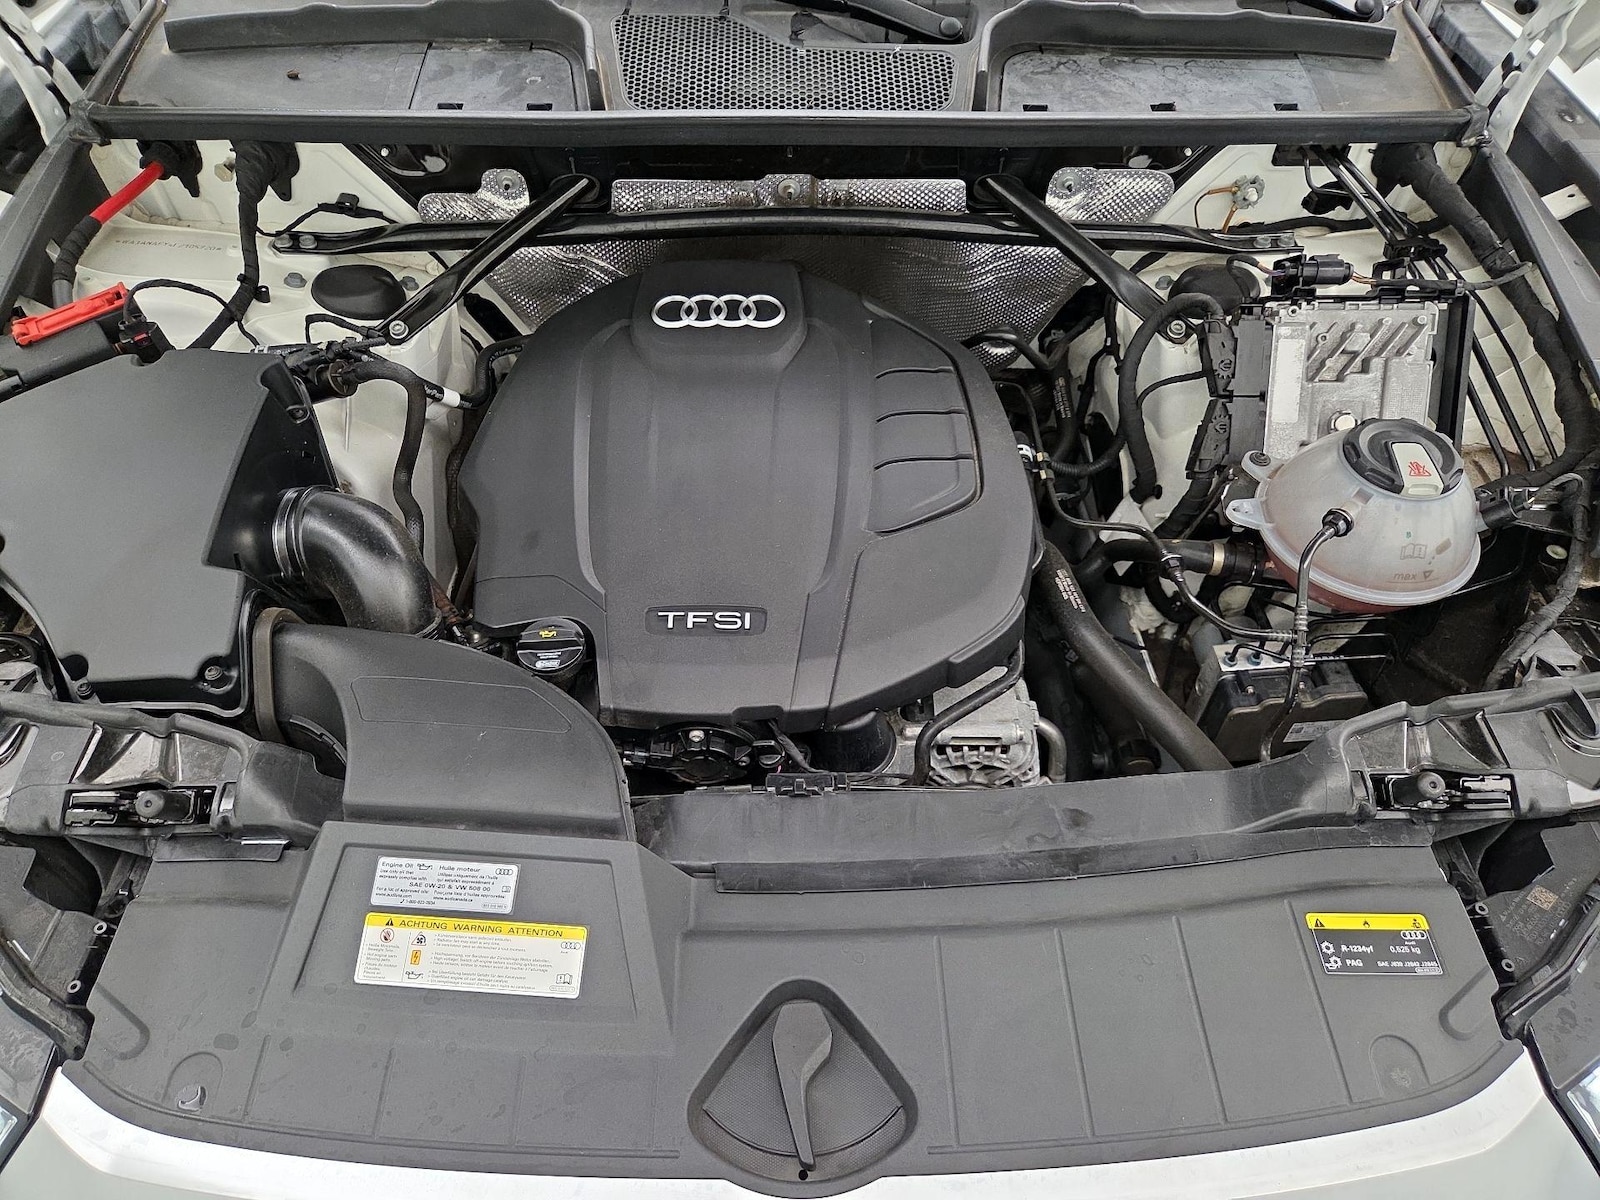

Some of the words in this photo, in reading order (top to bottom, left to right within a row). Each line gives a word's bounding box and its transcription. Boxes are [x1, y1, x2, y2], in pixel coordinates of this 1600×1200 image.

[657, 611, 751, 630] TFSI
[399, 920, 448, 930] ACHTUNG
[453, 924, 502, 933] WARNING
[508, 927, 564, 936] ATTENTION
[1341, 945, 1374, 954] R-1234yf
[1390, 946, 1410, 954] 0,525
[1411, 946, 1420, 954] kg
